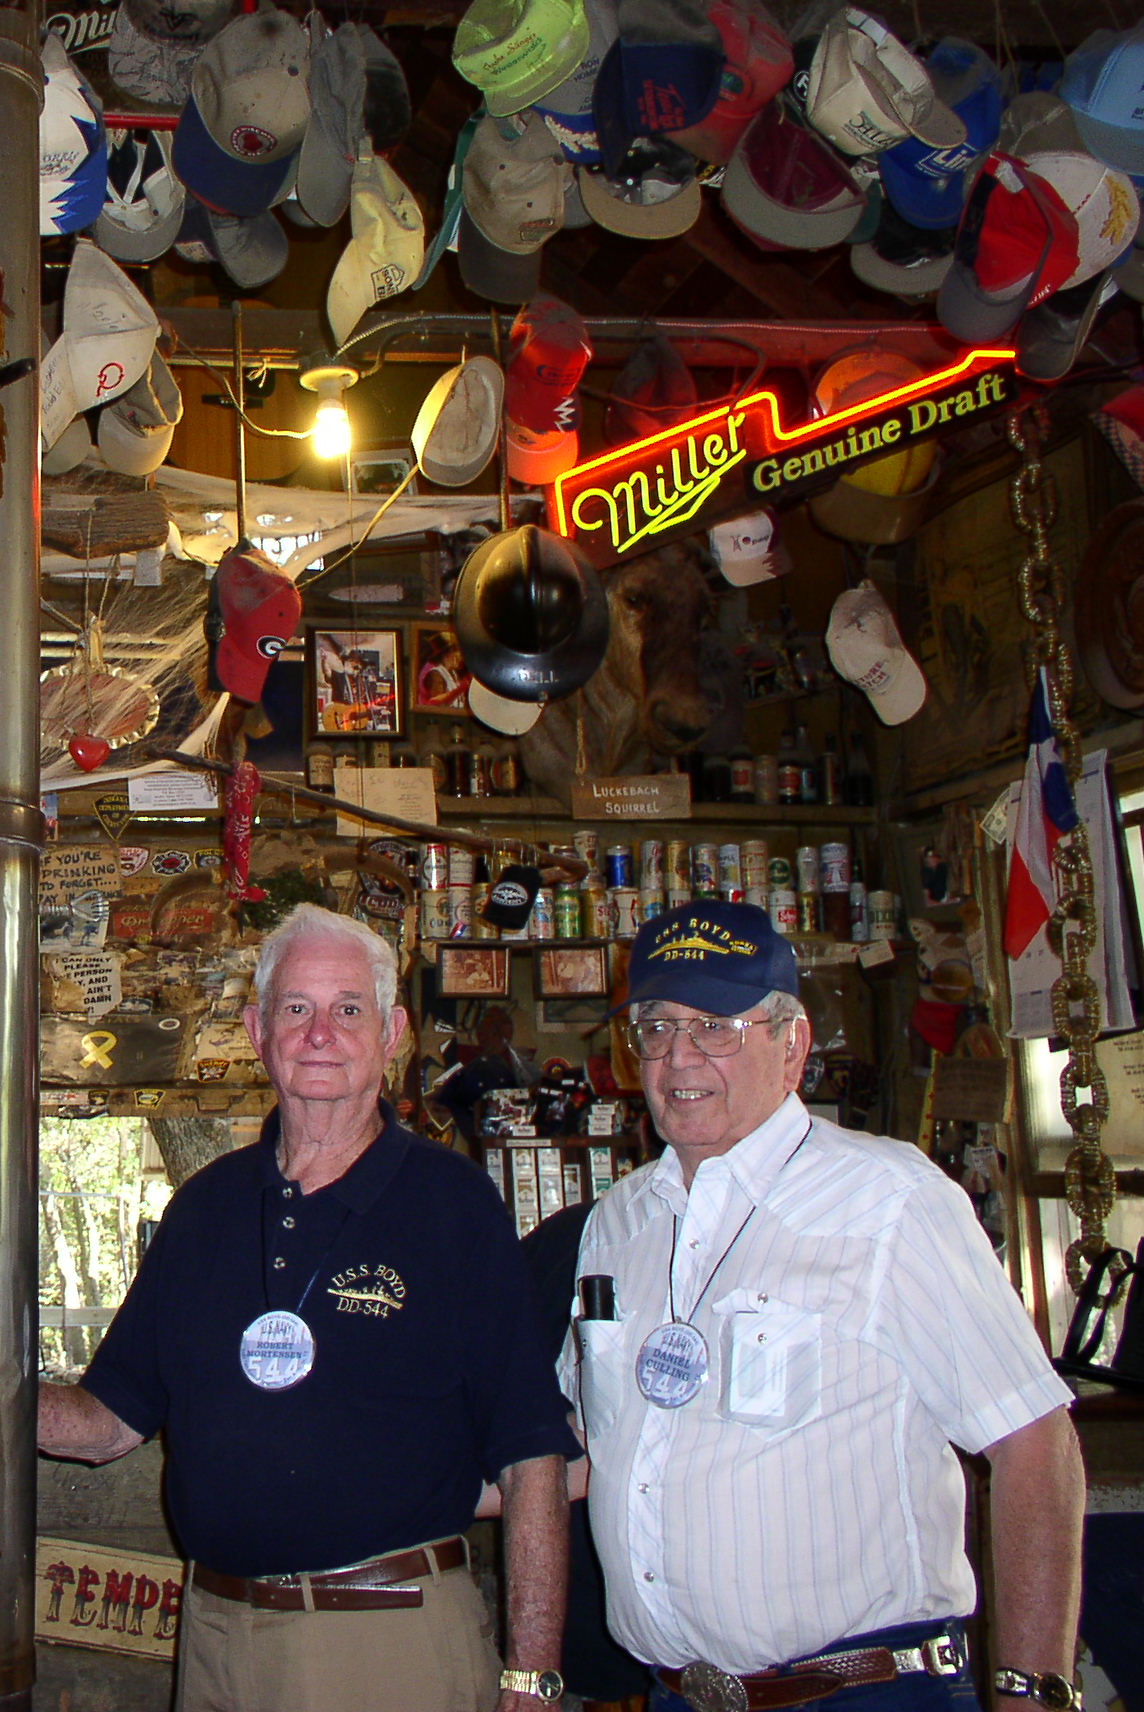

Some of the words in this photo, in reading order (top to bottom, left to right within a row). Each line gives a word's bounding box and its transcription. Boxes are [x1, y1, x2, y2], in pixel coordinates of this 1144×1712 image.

[753, 418, 902, 493] Genuine
[908, 372, 1006, 435] Draft
[571, 411, 745, 547] Miller
[592, 783, 660, 798] LUCKEBACH
[605, 801, 660, 814] SQUIRREL
[56, 852, 102, 864] YOU'RE
[41, 864, 116, 879] DRINKING
[40, 881, 55, 890] TO
[689, 918, 732, 942] BOYD
[64, 963, 101, 971] PLEASE
[74, 968, 113, 978] PERSON
[88, 976, 109, 985] AND
[86, 985, 113, 995] AIN'T
[83, 994, 112, 1005] DAMN
[374, 1264, 407, 1298] BOYD
[336, 1297, 389, 1319] DD-544
[256, 1341, 295, 1350] ROBERT
[246, 1350, 303, 1359] MORTENSEN
[652, 1348, 691, 1369] DANIEL
[646, 1358, 691, 1382] CULLING
